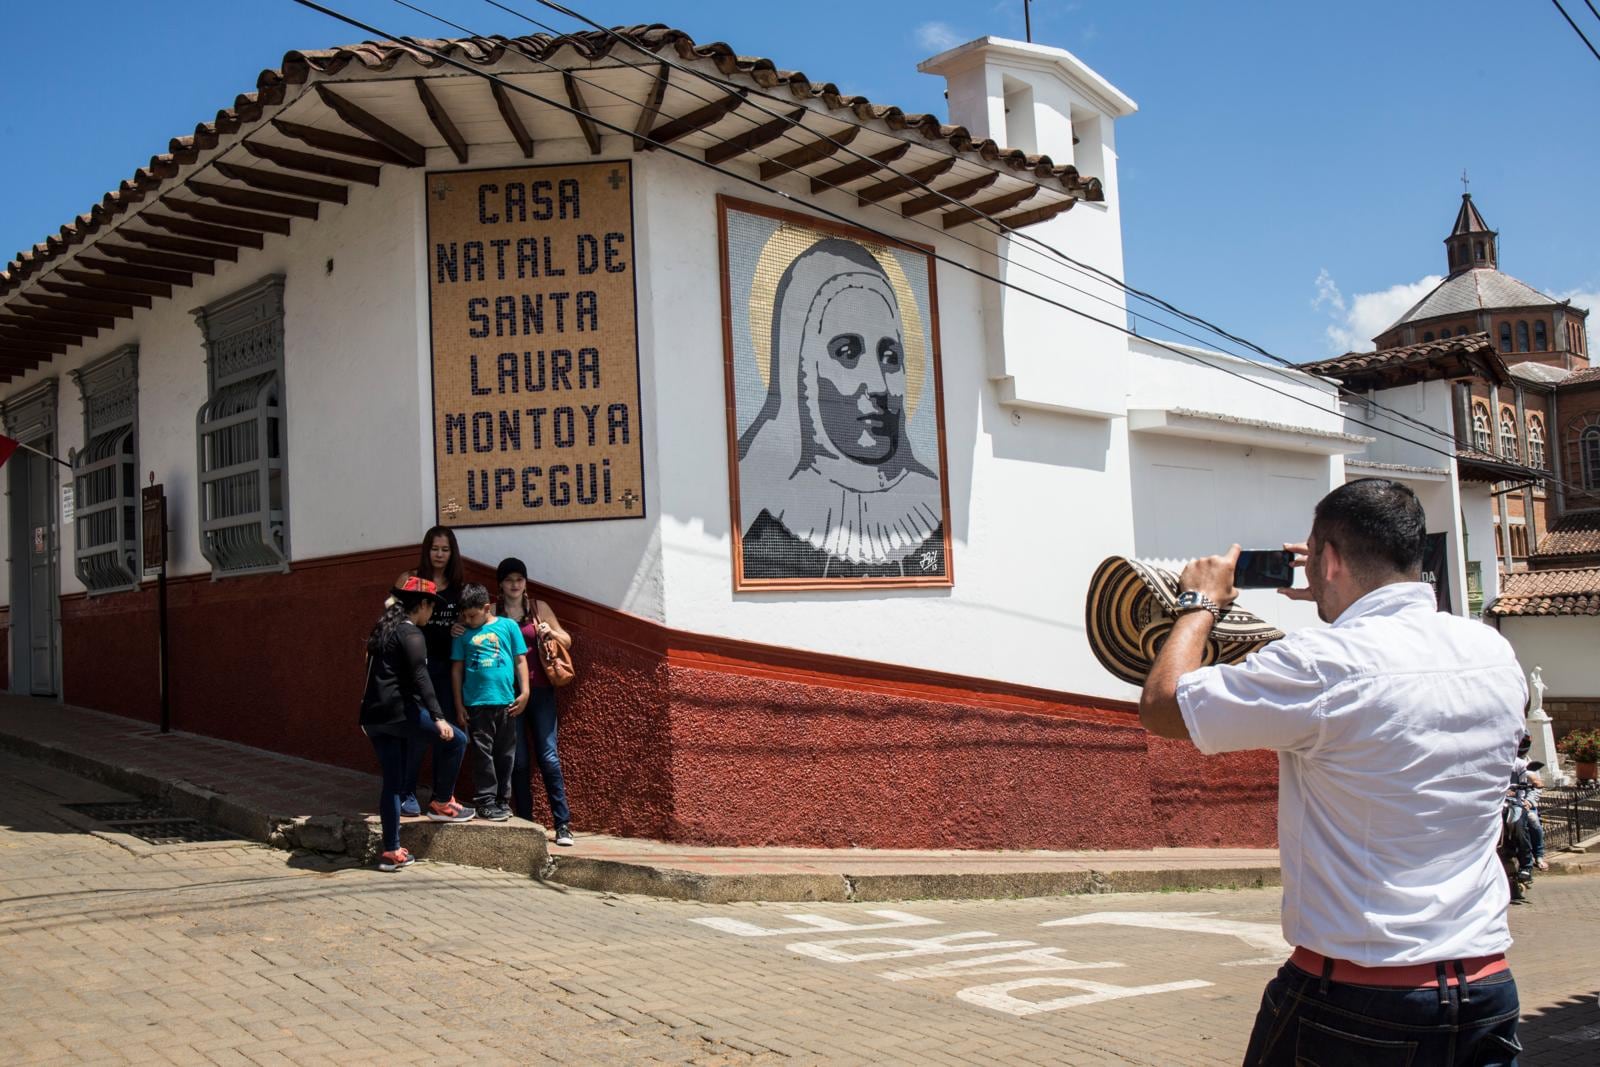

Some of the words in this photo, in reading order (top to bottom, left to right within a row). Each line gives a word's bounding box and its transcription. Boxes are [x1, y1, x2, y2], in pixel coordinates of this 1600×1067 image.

[478, 178, 581, 225] CASA
[436, 236, 565, 284] NATAL
[577, 232, 626, 278] DE
[468, 290, 599, 339] SANTA
[470, 347, 600, 396] LAURA
[445, 403, 630, 455] MONTOYA
[687, 909, 1216, 1016] PARE
